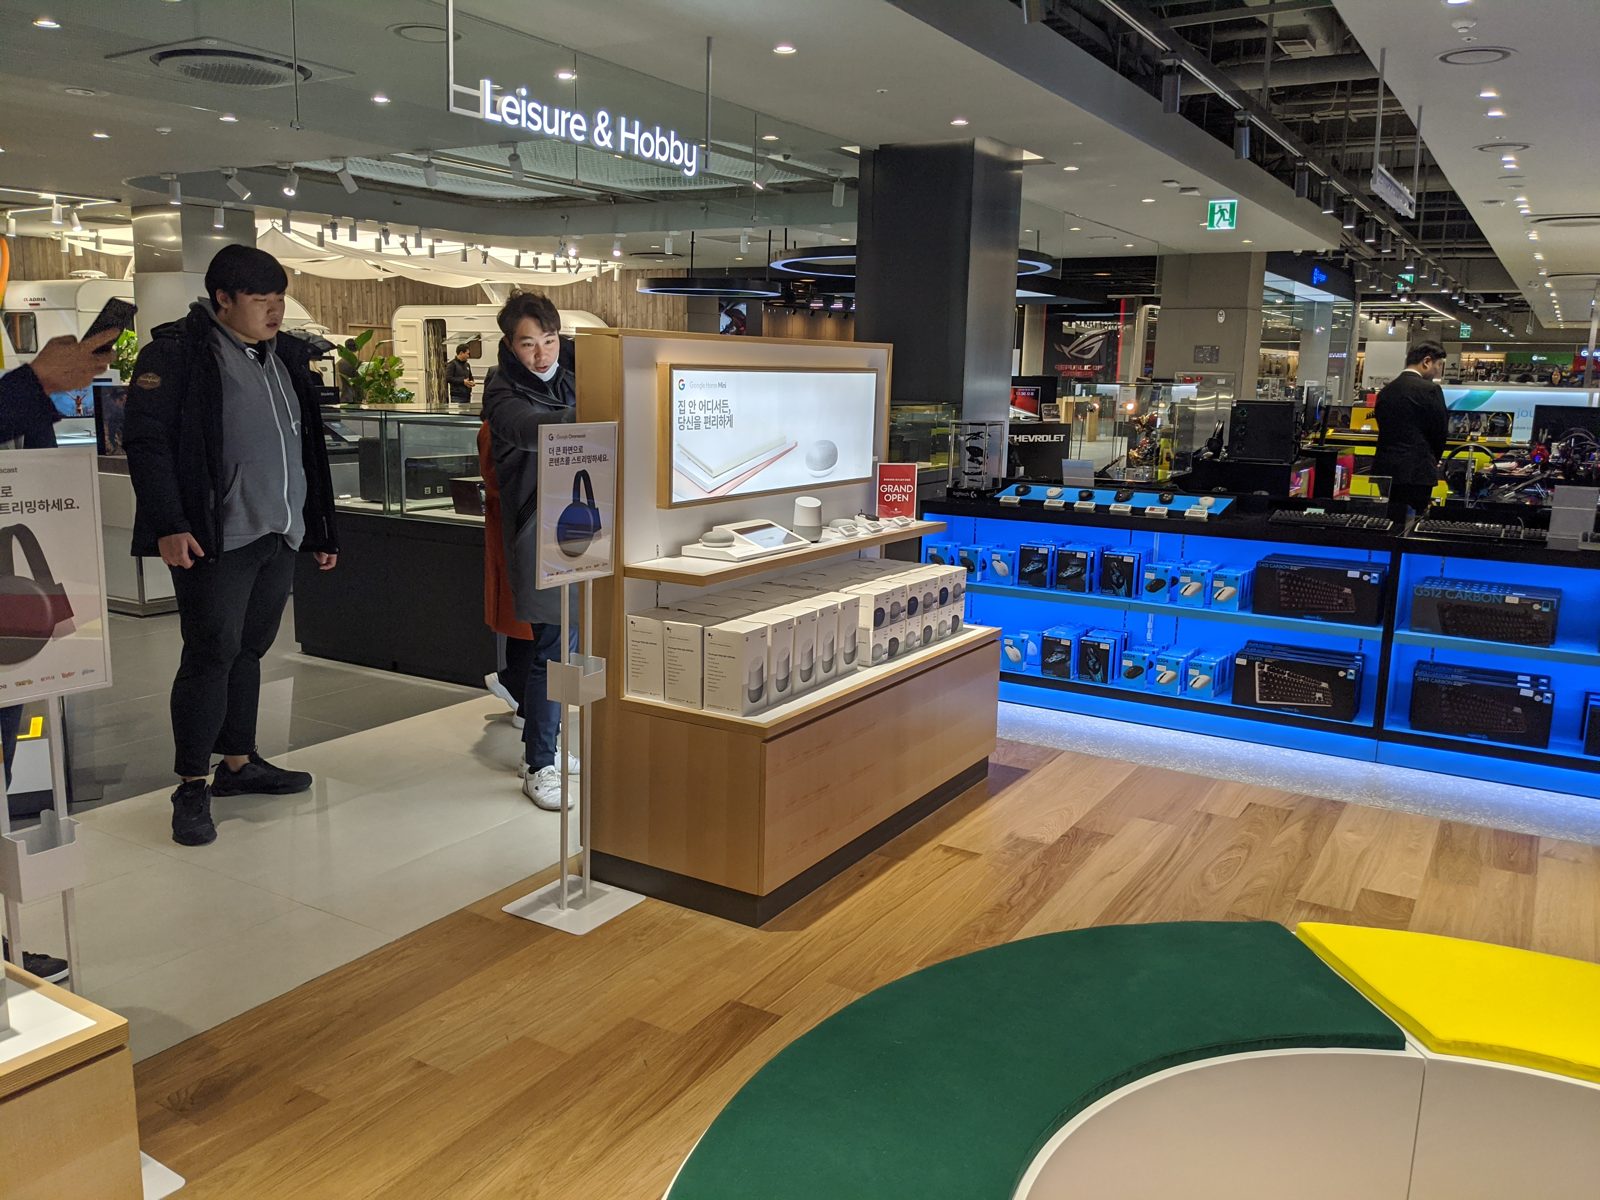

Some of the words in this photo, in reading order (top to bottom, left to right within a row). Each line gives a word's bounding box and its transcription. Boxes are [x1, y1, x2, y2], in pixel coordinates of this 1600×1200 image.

[480, 79, 587, 141] Leisure
[594, 110, 613, 149] &
[620, 117, 697, 177] Hobby
[678, 399, 686, 415] 집
[688, 399, 697, 415] 안
[699, 399, 731, 415] 어디서든,
[678, 416, 701, 431] 당신을
[704, 414, 733, 430] 편리하게
[880, 484, 914, 493] GRAND
[883, 493, 909, 502] OPEN
[1415, 587, 1441, 598] G512
[1445, 590, 1502, 603] CARBON
